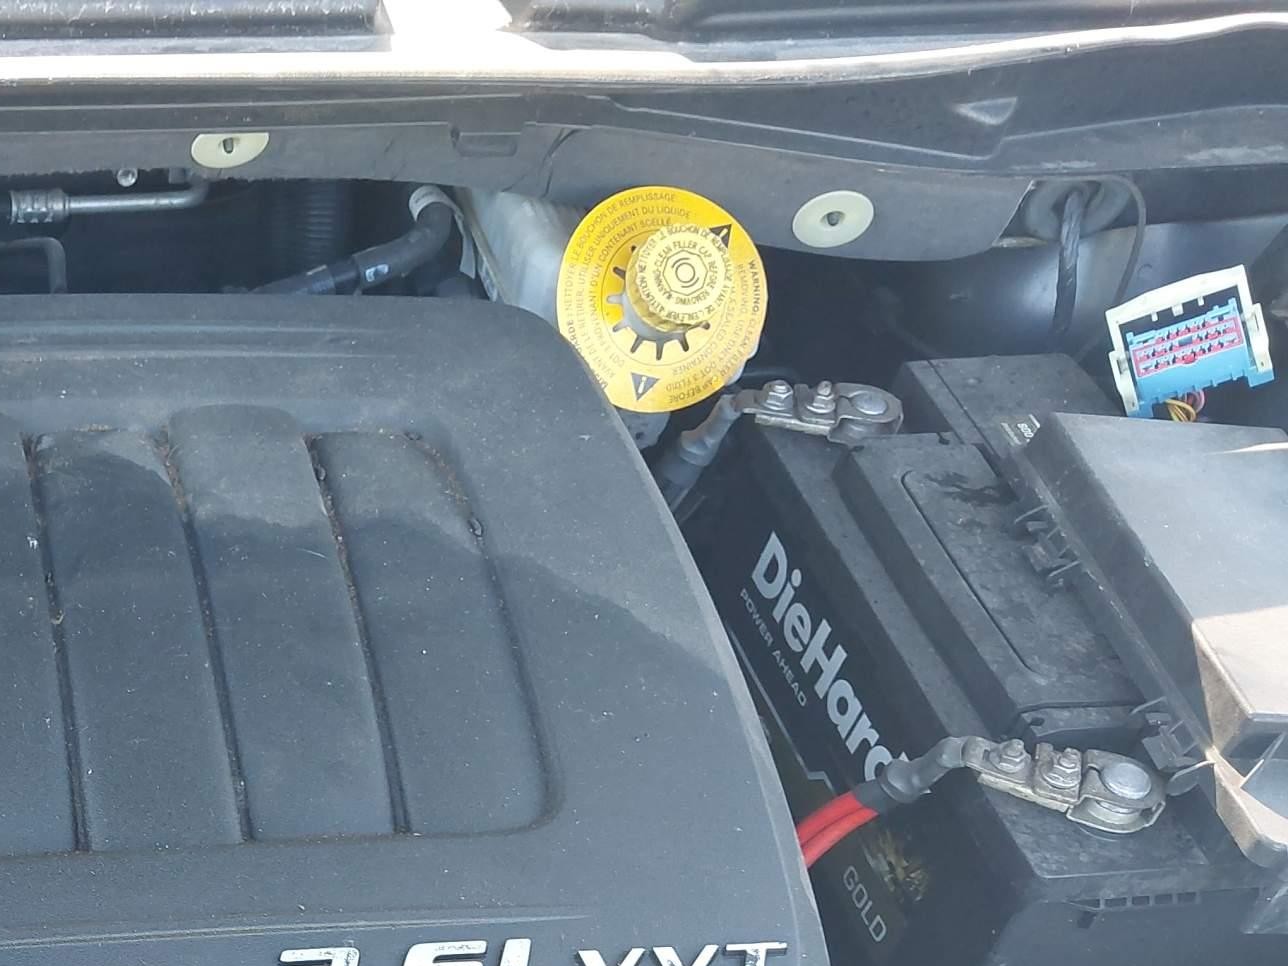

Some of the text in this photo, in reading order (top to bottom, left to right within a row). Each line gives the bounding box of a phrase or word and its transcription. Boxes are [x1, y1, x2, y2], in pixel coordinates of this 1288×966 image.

[574, 210, 608, 249] BOUCHON
[604, 202, 618, 216] DE
[617, 189, 674, 210] REMPLISSAGE
[590, 207, 640, 247] UNIQUEMENT
[639, 205, 654, 216] DU
[654, 205, 690, 219] LIQUIDE
[595, 221, 639, 262] CONTENANT
[671, 238, 698, 250] FILLER
[668, 383, 704, 403] BEFORE
[739, 588, 807, 707] POWER AHEAD
[842, 864, 888, 943] GOLD
